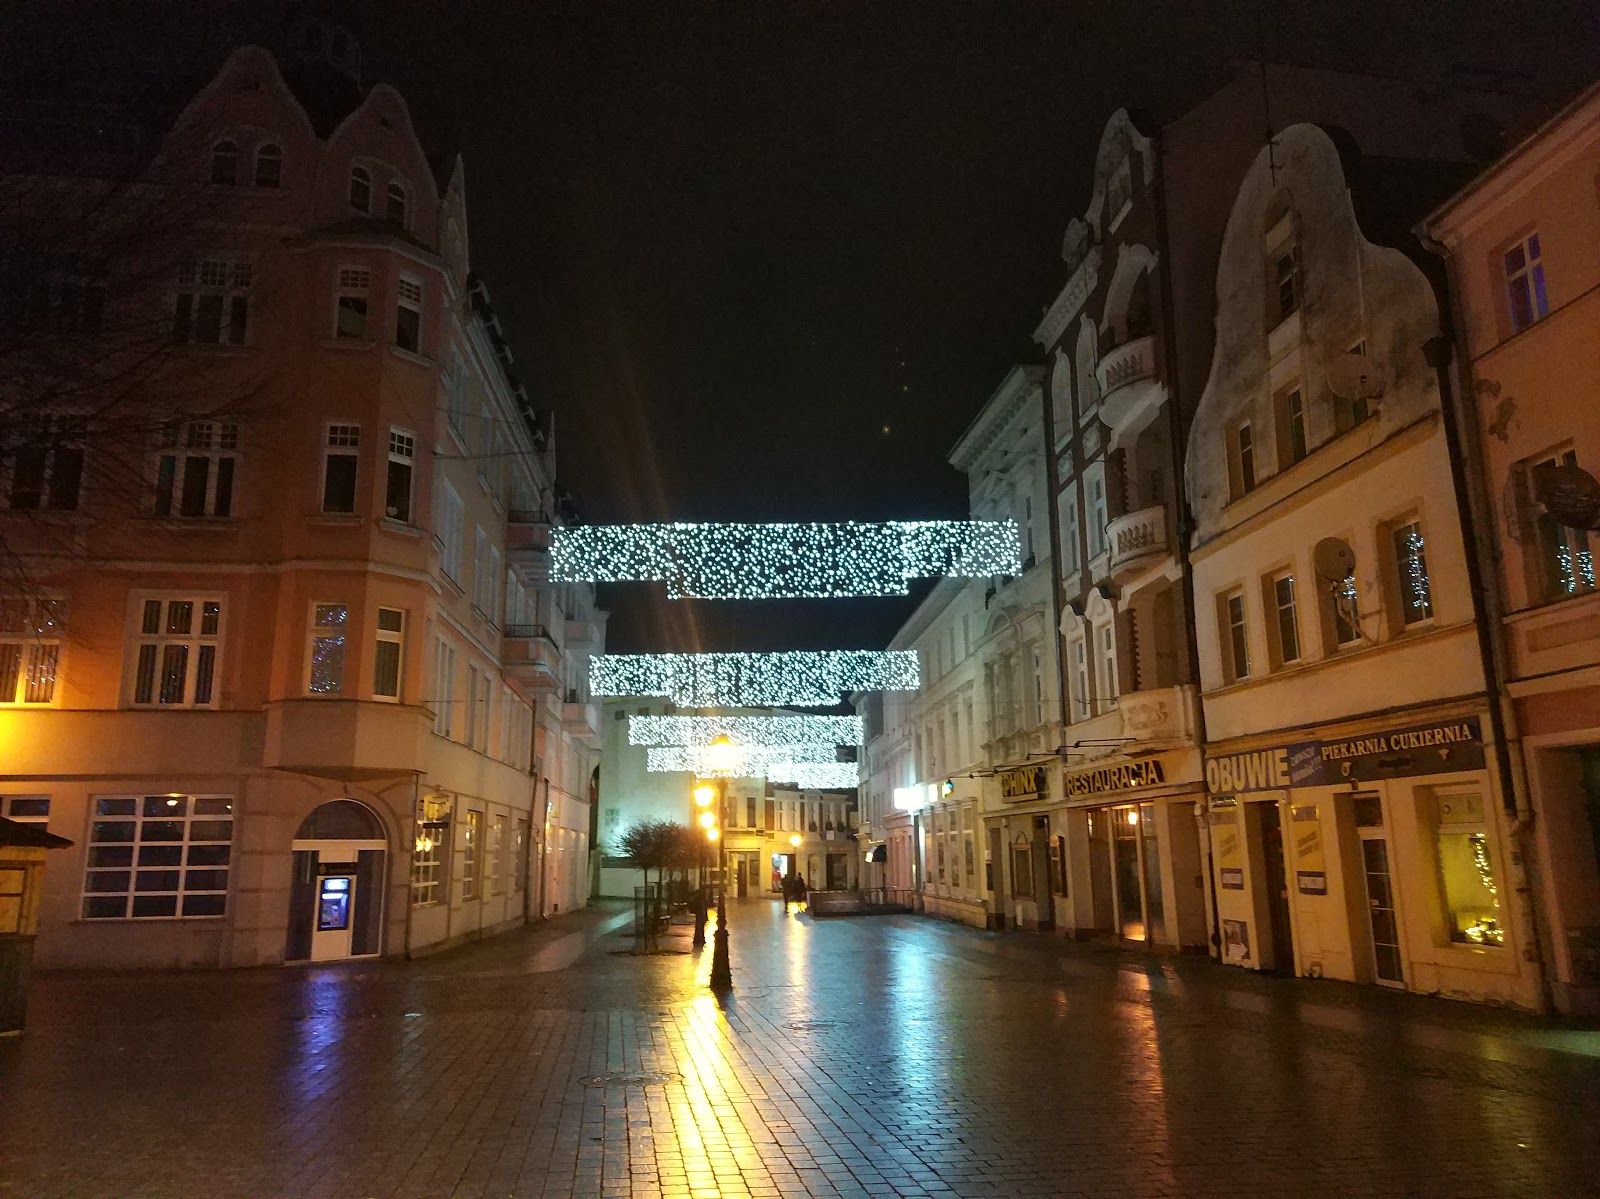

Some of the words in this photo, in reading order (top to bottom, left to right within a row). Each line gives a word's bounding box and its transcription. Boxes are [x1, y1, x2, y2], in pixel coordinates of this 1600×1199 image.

[1321, 737, 1388, 760] PIEKARNIA
[1390, 724, 1473, 751] CUKIERNIA
[1067, 759, 1161, 795] RESTAURACJA
[1206, 748, 1290, 794] OBUWIE
